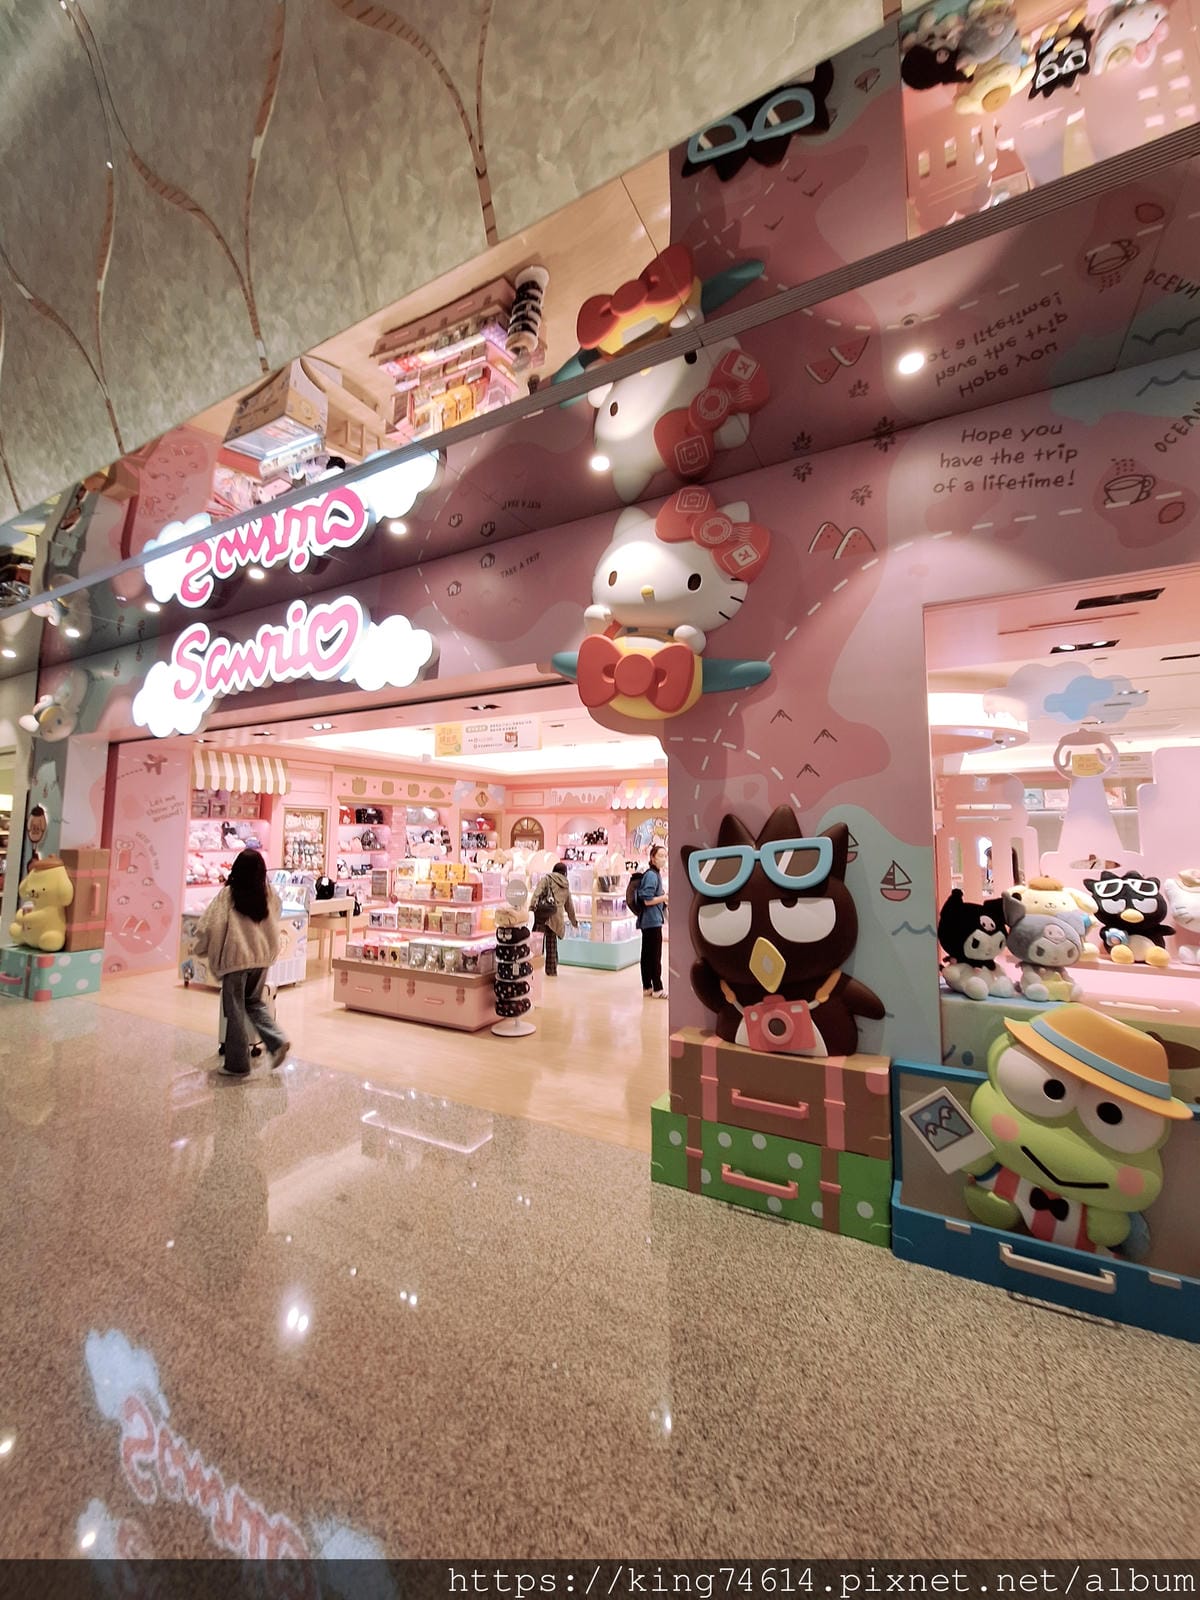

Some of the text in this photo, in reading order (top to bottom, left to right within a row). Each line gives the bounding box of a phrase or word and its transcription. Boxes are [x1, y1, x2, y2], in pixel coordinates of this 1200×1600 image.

[961, 423, 1063, 445] Hope you
[940, 443, 1078, 468] have the trip
[933, 469, 1075, 493] of a lifetime!
[172, 599, 362, 702] Sanrio
